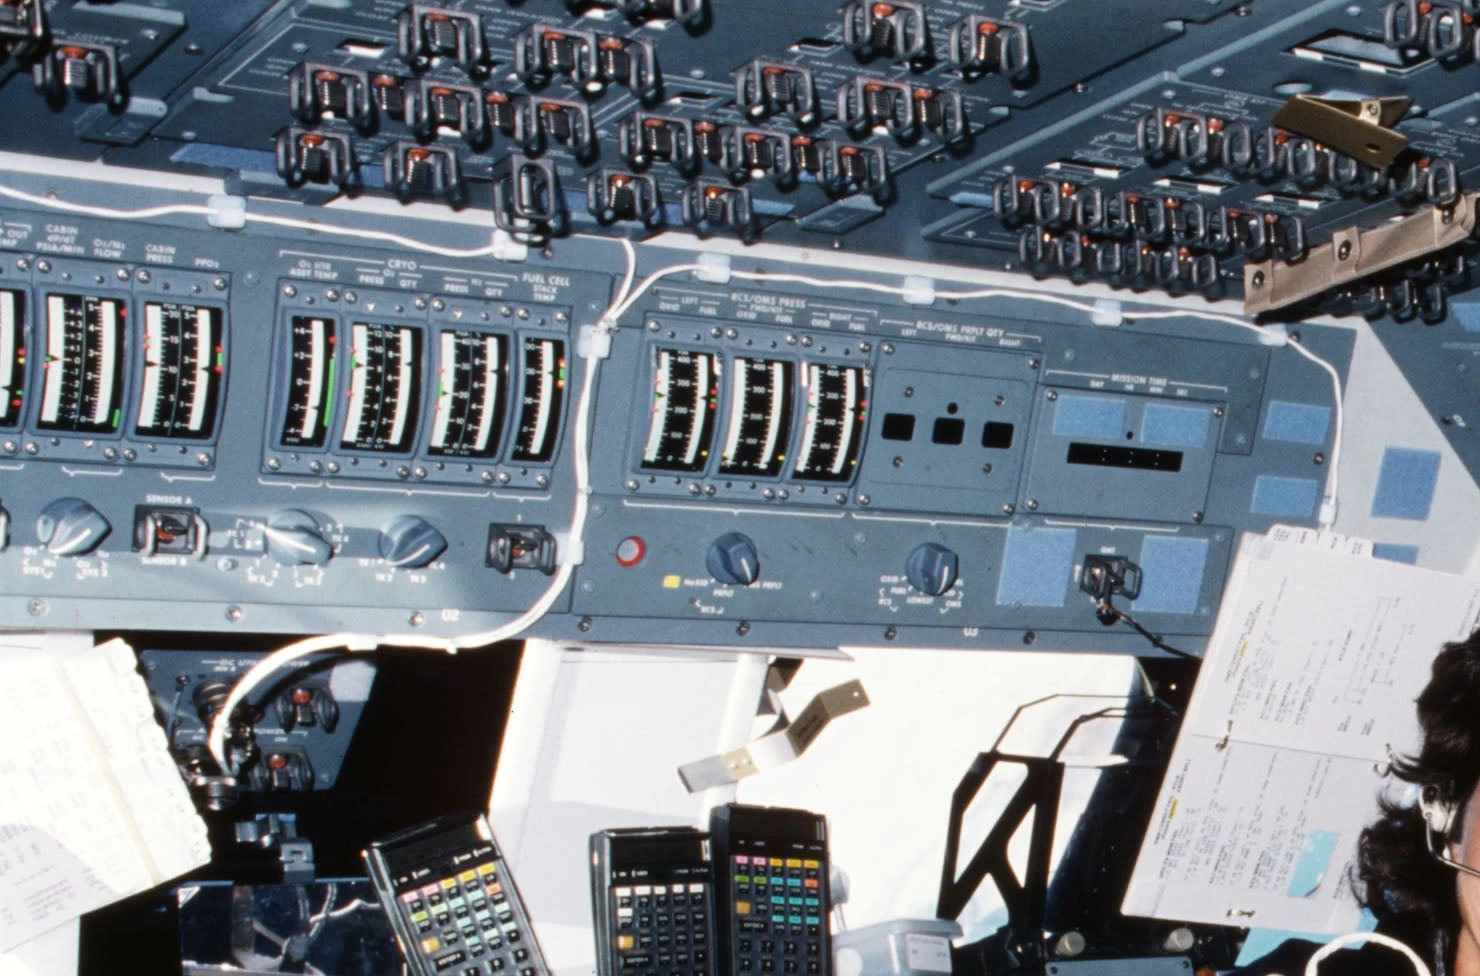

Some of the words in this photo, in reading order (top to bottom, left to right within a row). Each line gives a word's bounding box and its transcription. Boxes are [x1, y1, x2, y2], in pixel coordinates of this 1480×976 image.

[45, 224, 78, 235] CABIN
[93, 248, 122, 258] FLOW
[145, 244, 176, 255] CABIN
[146, 253, 173, 264] PRESS
[387, 259, 417, 270] CRYO
[523, 273, 545, 284] FUEL
[548, 275, 570, 286] CELL
[778, 298, 806, 309] PRESS
[1111, 373, 1147, 385] MISSION
[1149, 377, 1168, 386] TIME
